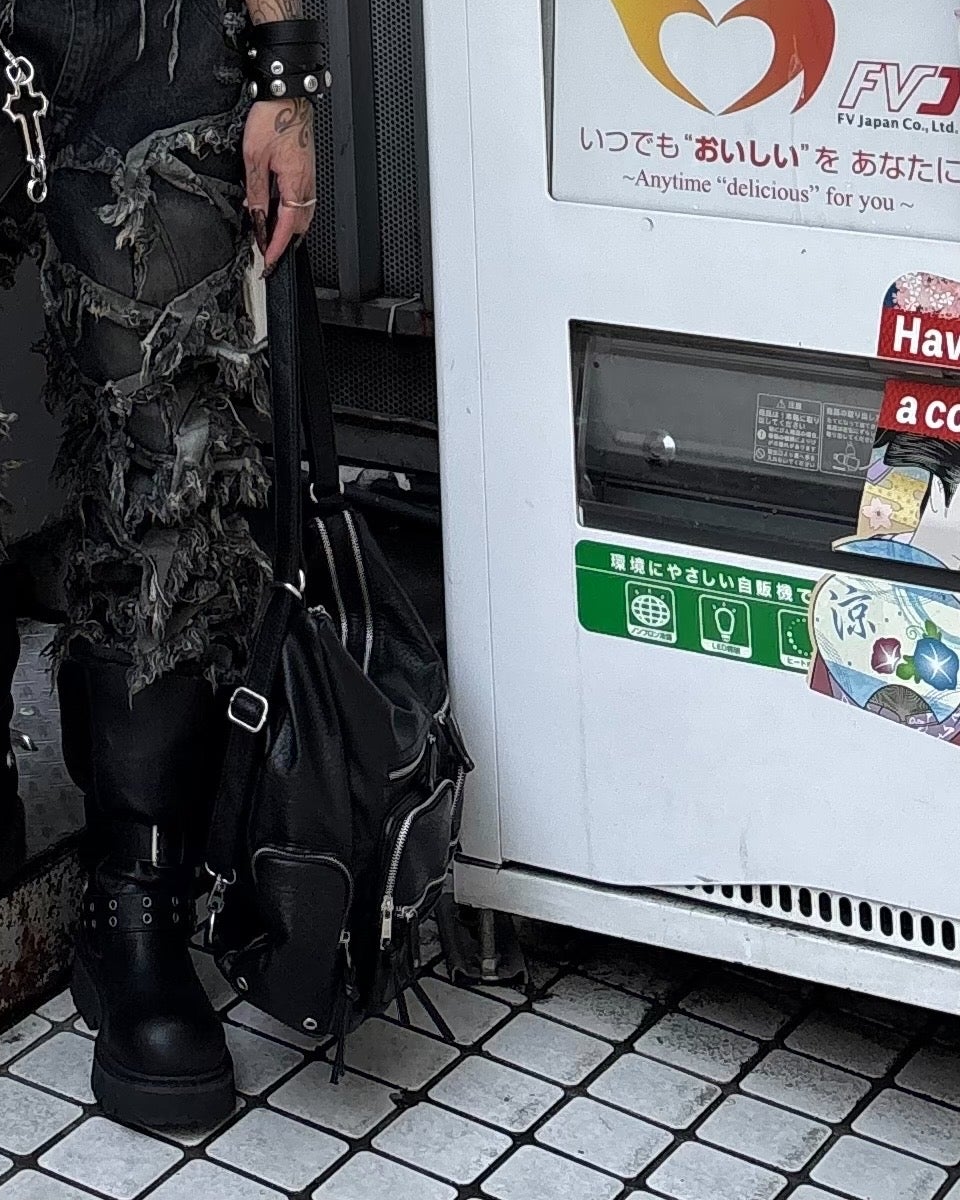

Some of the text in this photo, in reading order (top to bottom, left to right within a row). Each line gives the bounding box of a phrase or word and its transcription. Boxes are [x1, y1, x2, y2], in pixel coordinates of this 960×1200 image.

[837, 113, 855, 125] FV
[857, 115, 899, 129] Japan
[932, 120, 959, 134] Ltd.
[852, 149, 960, 184] あなたに
[826, 186, 853, 207] for
[859, 197, 895, 214] you
[895, 395, 919, 425] a
